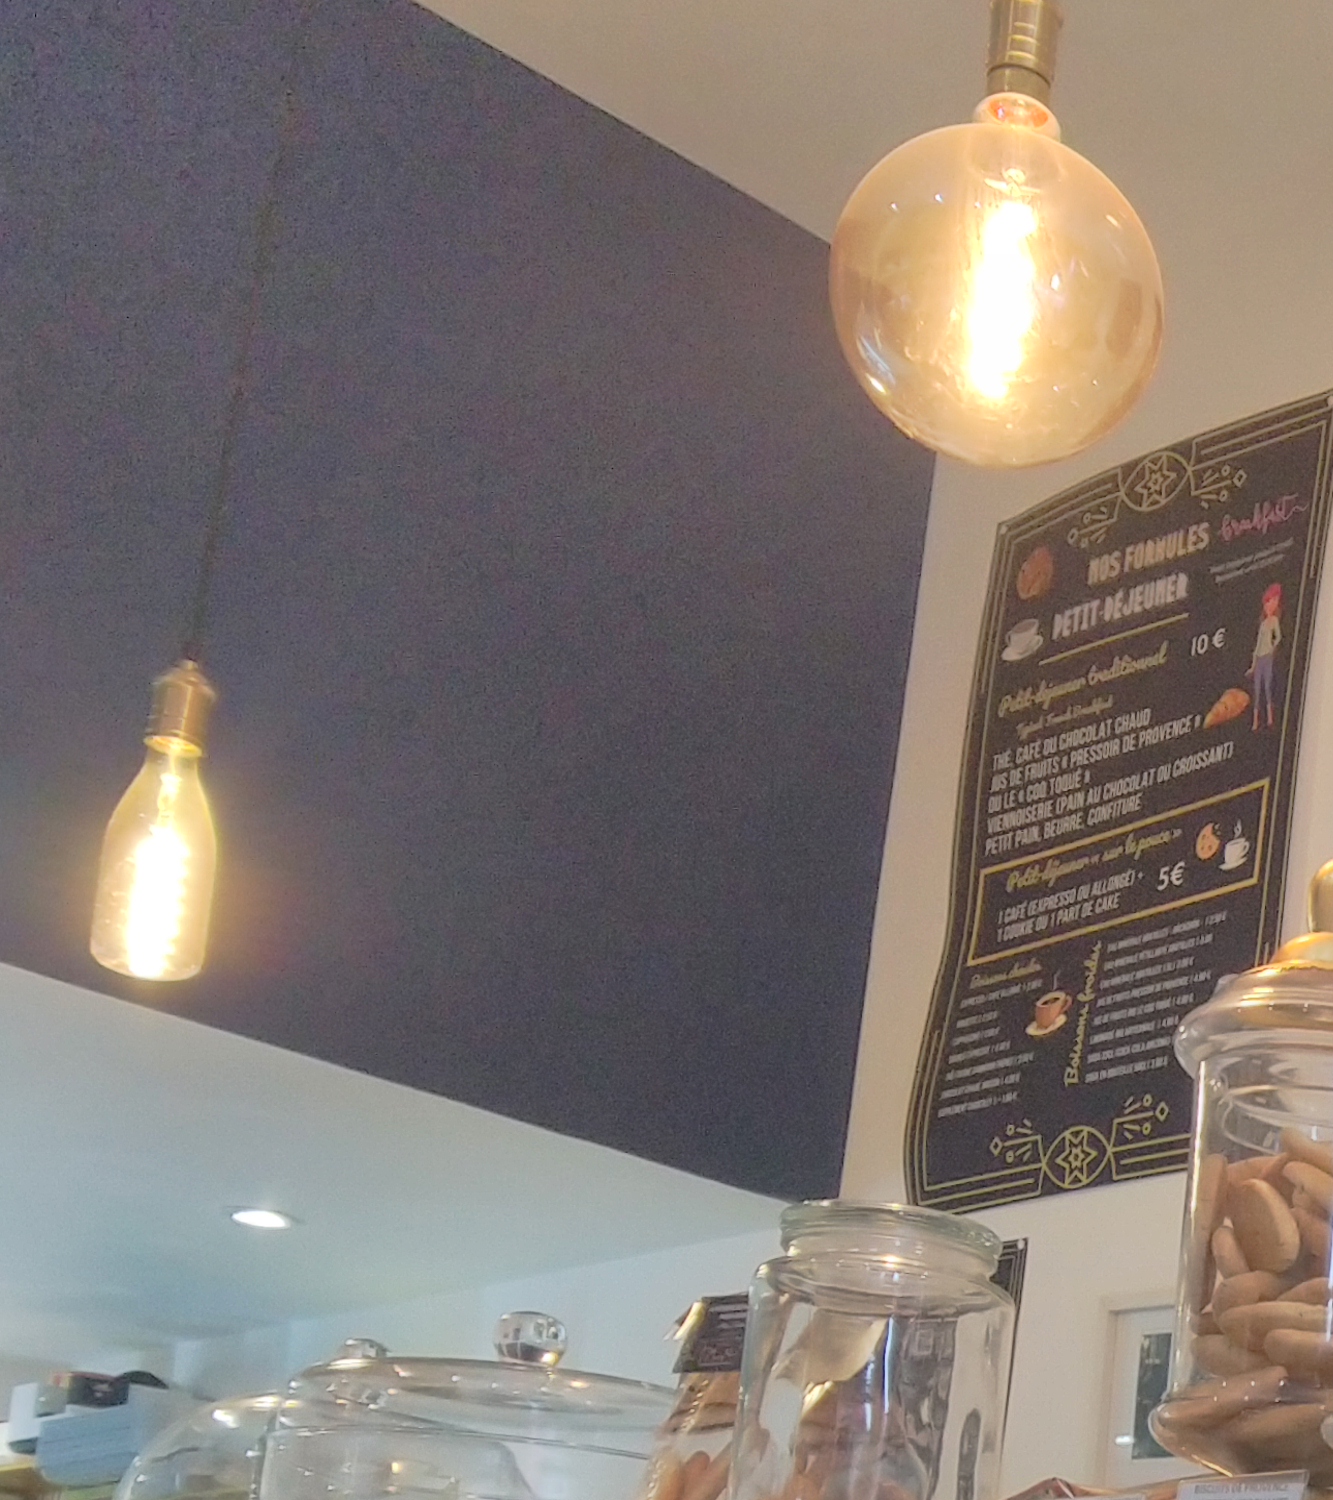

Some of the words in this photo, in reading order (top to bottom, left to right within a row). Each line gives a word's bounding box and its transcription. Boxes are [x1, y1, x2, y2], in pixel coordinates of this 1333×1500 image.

[1087, 550, 1121, 585] NOS
[1123, 521, 1209, 572] FORMULES
[1052, 572, 1188, 639] PETIT-DÉJEUNER
[1190, 633, 1209, 656] 10
[1211, 627, 1225, 648] €
[1042, 735, 1057, 756] OU
[1058, 718, 1112, 750] CHOCOLAT
[1114, 707, 1151, 734] CHAUD
[1156, 860, 1185, 891] 5€
